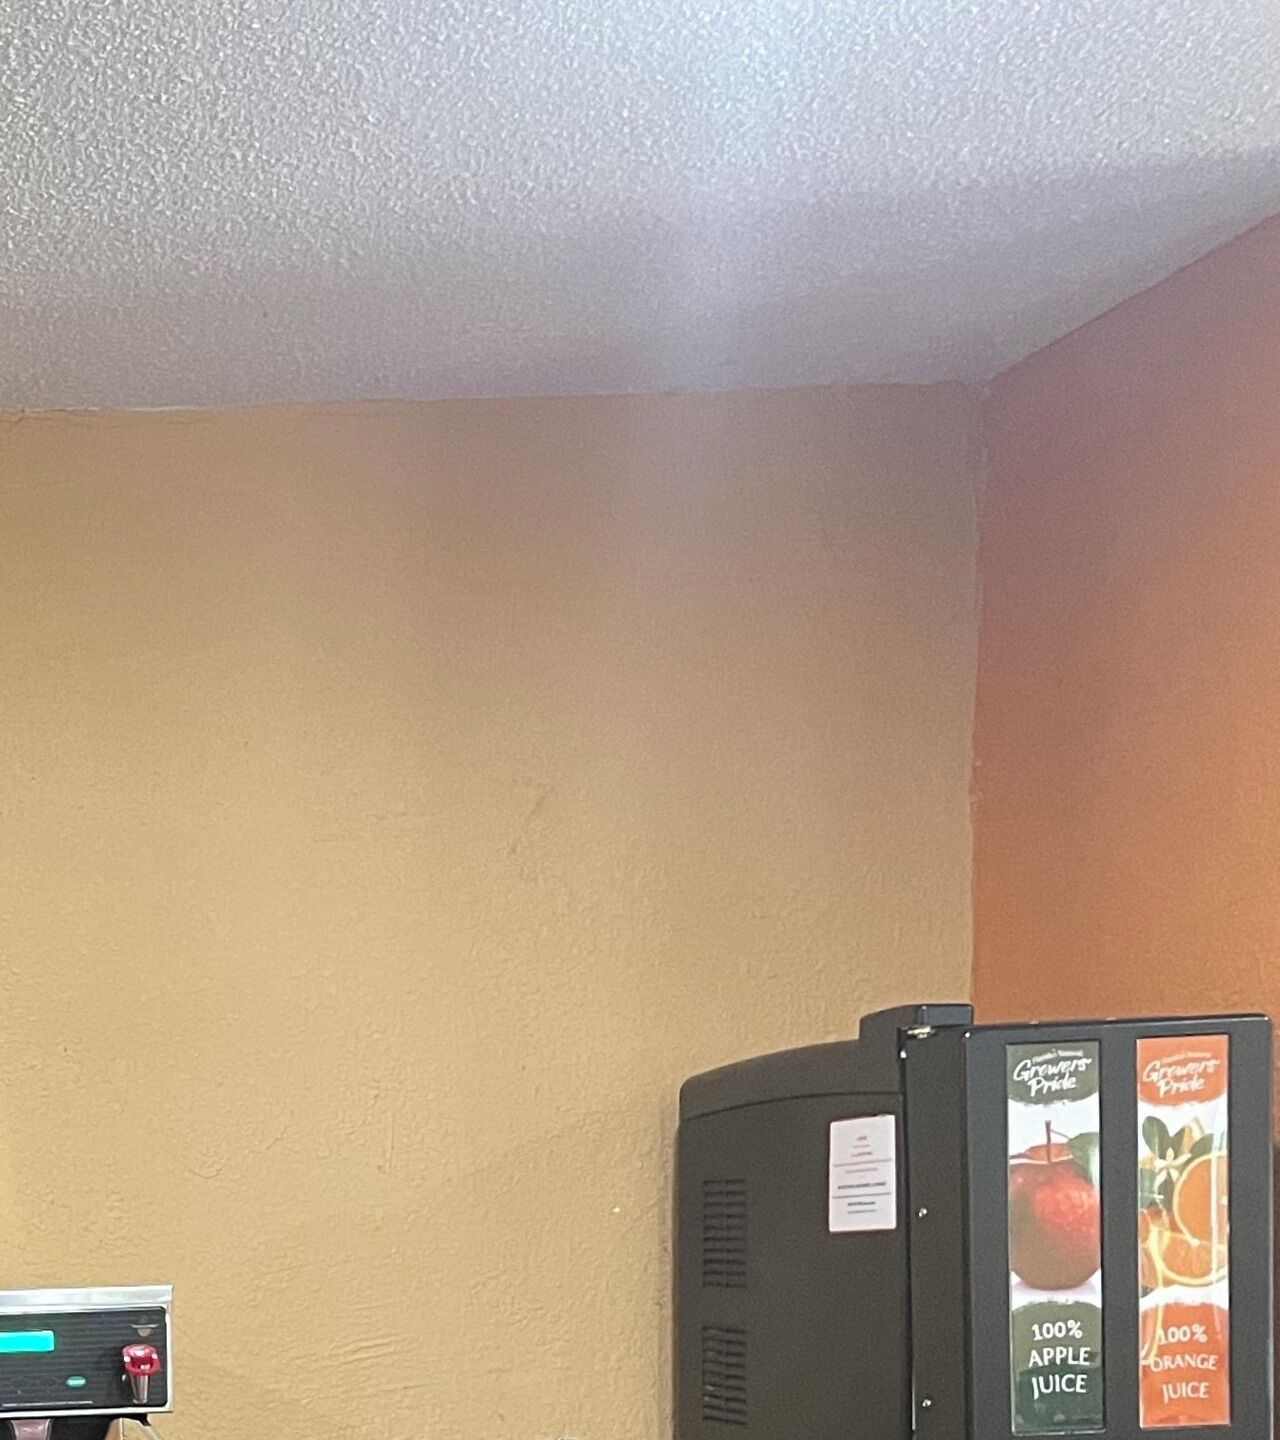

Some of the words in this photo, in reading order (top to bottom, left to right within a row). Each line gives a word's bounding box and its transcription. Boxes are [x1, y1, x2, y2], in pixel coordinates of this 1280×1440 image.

[1013, 1057, 1092, 1081] Growers
[1142, 1058, 1220, 1082] Growers
[1027, 1072, 1077, 1097] Pride
[1156, 1073, 1205, 1098] Pride
[1031, 1319, 1083, 1341] 100%
[1159, 1323, 1208, 1345] 100%
[1028, 1347, 1090, 1368] APPLE
[1150, 1354, 1219, 1372] ORANGE
[1031, 1374, 1088, 1400] JUICE
[1162, 1382, 1209, 1404] JUICE
